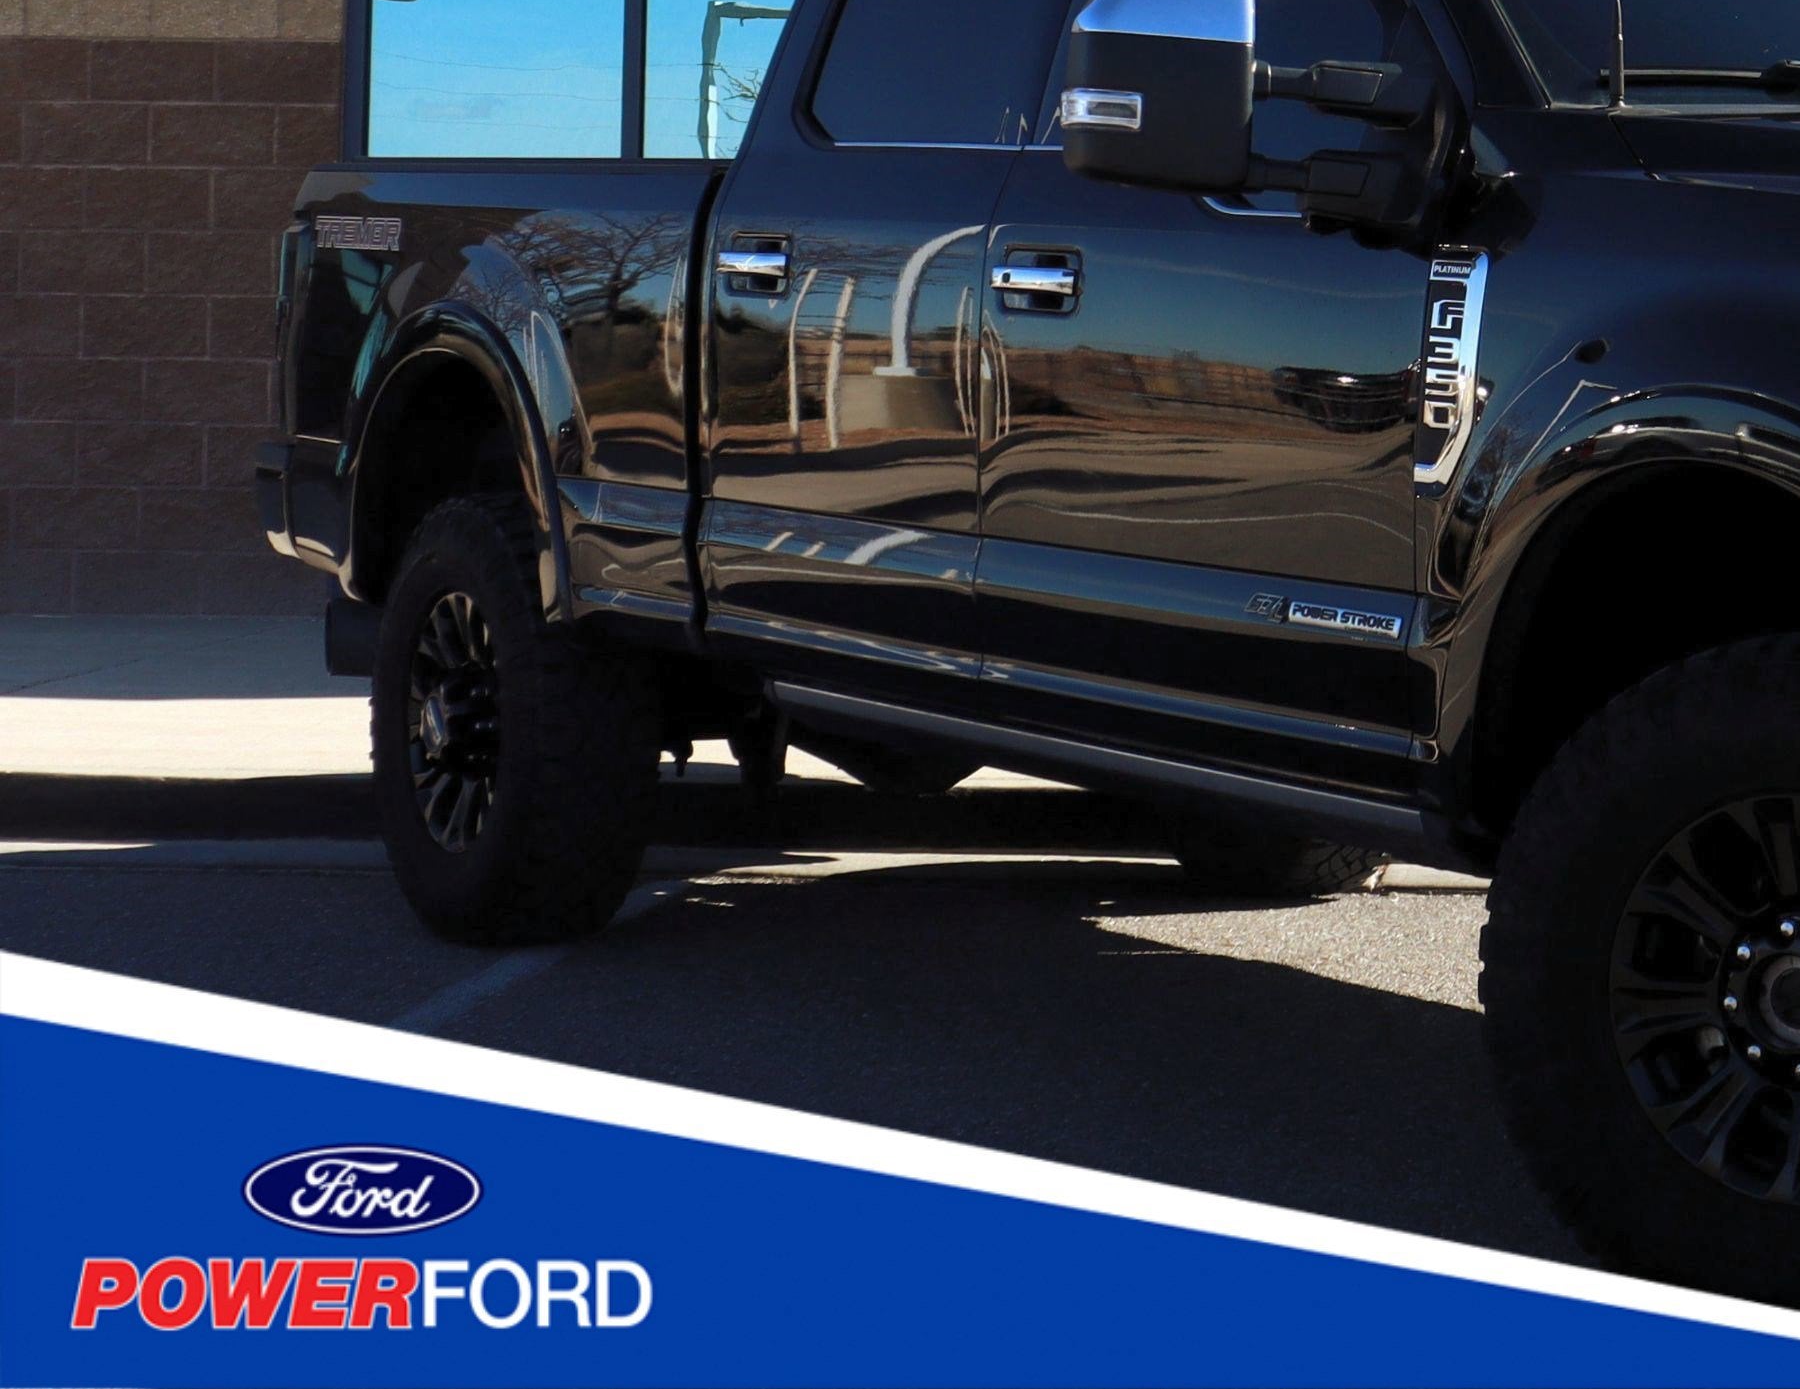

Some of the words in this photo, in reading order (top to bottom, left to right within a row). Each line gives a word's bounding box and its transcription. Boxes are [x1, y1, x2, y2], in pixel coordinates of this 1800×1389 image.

[315, 215, 402, 252] TREMOR
[1433, 264, 1472, 275] PLATINUM
[1292, 603, 1338, 622] POWER
[1340, 612, 1396, 631] STROKE
